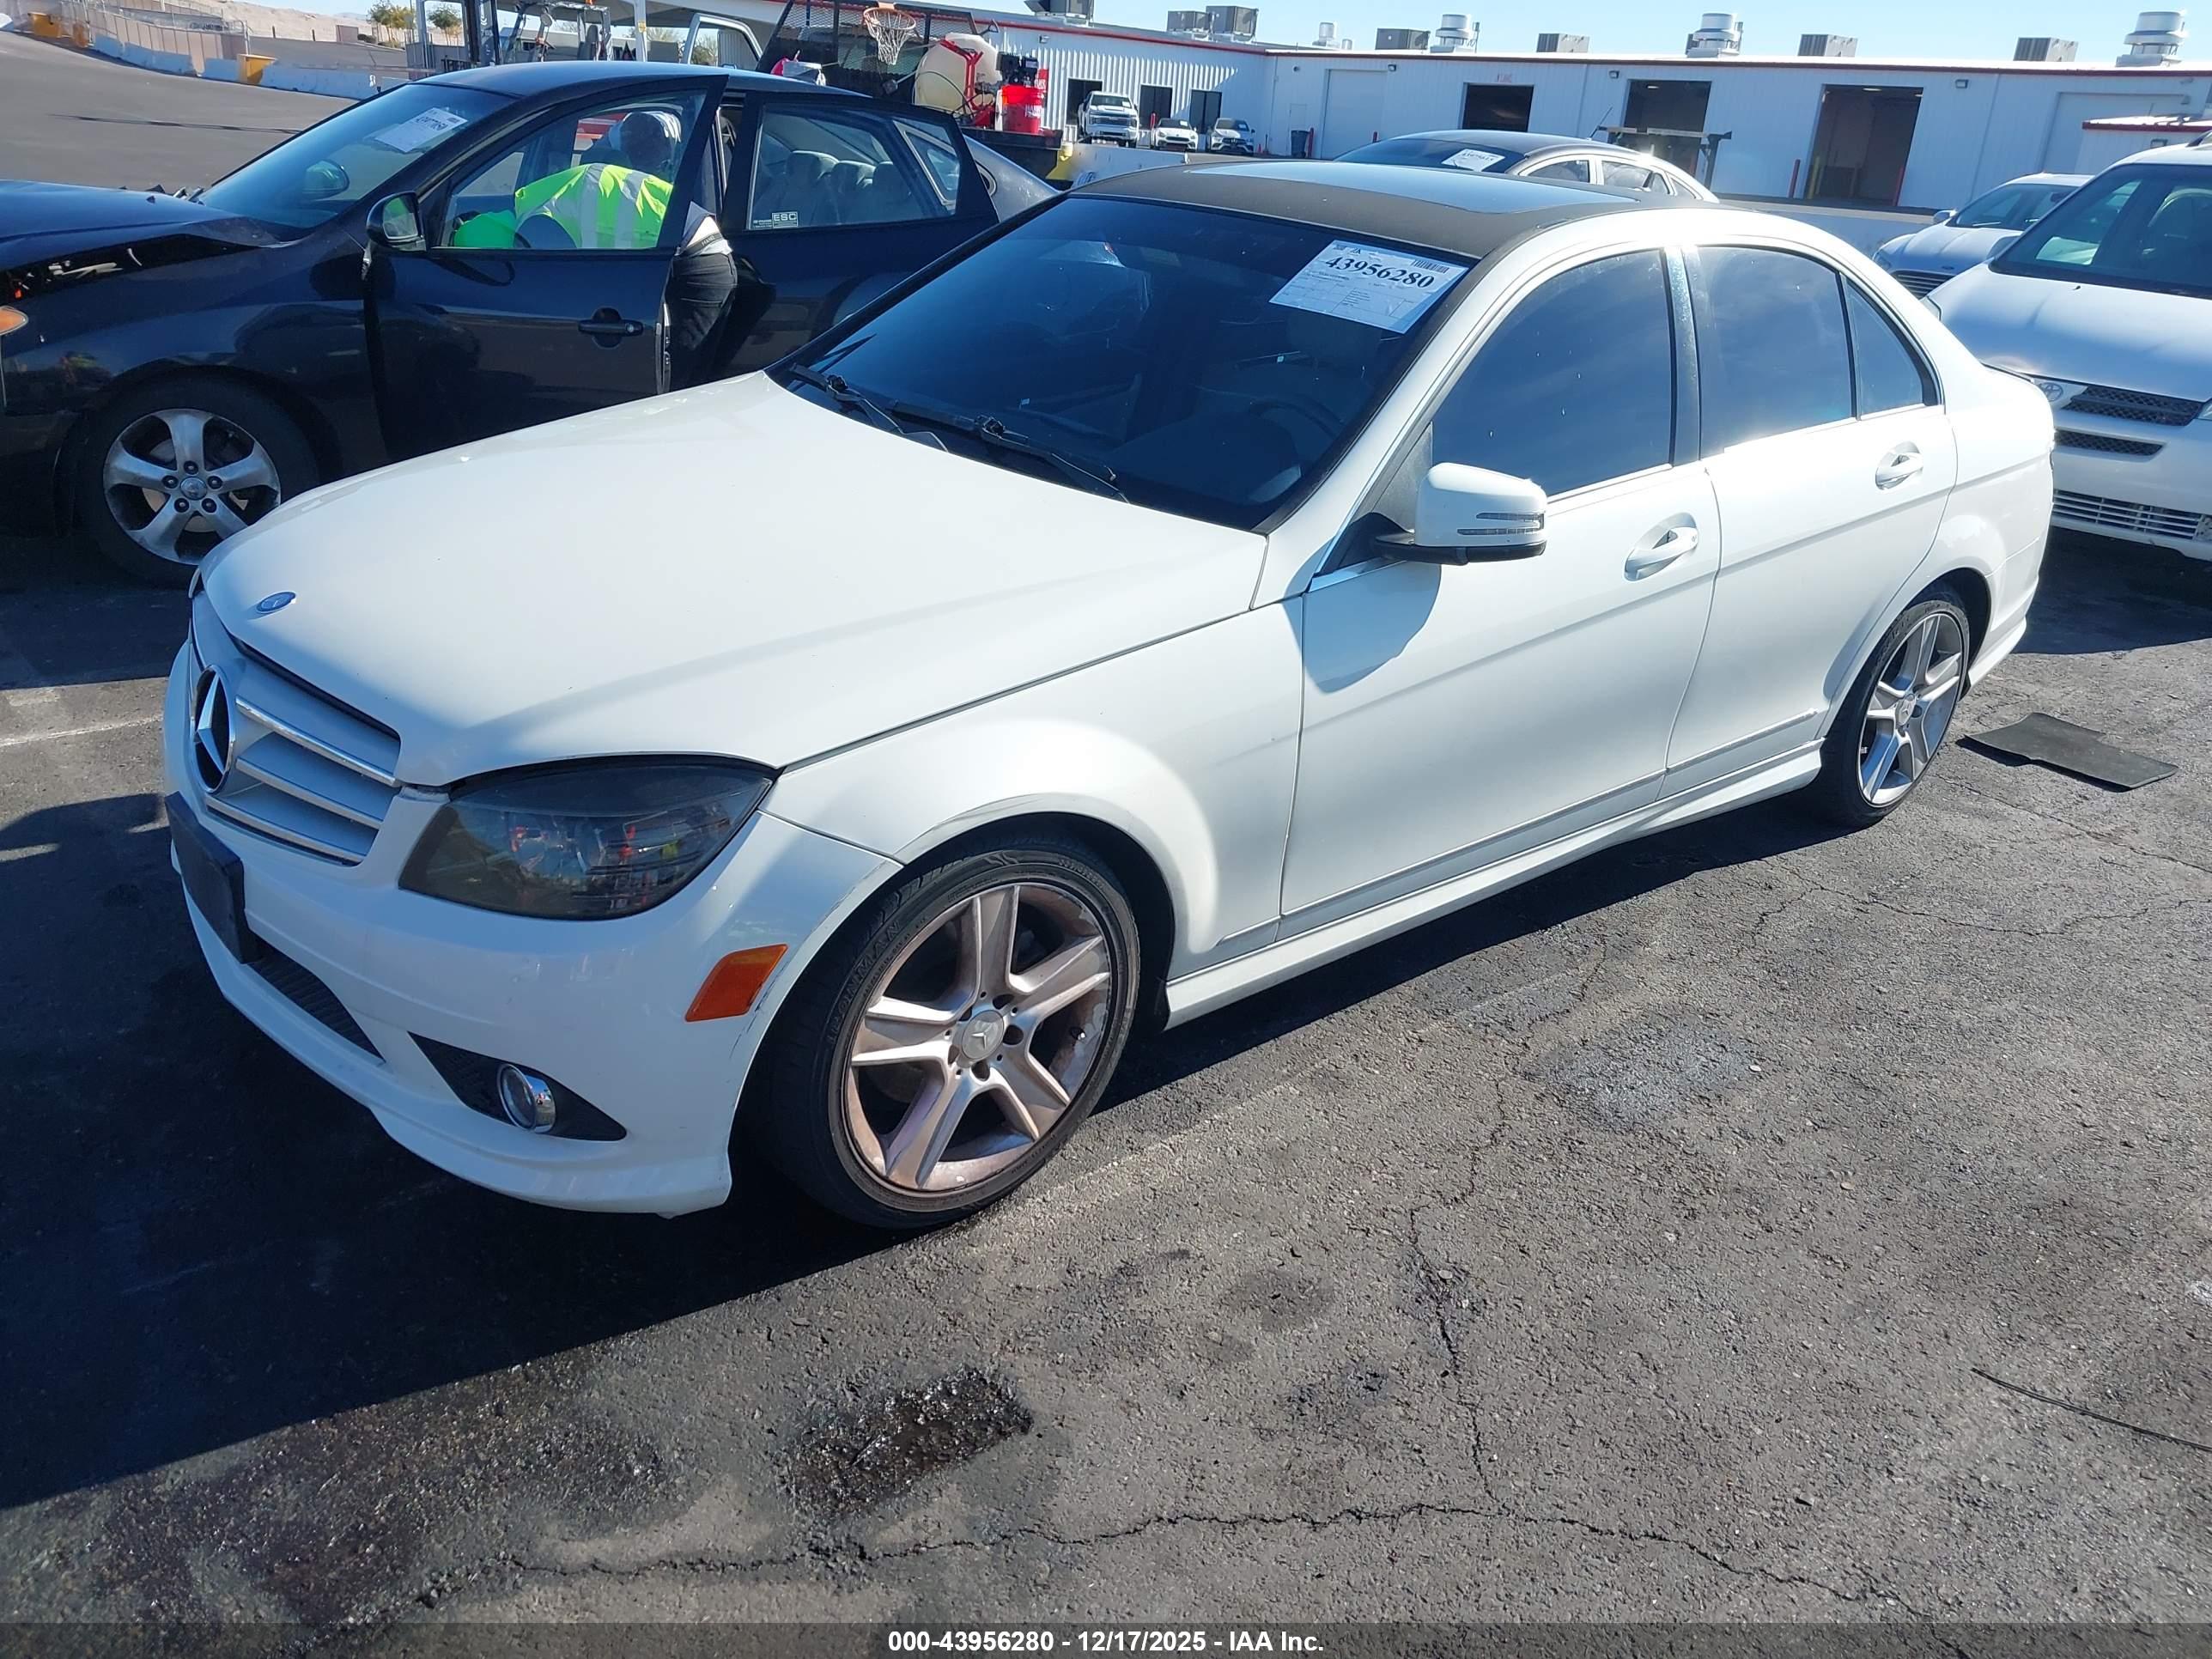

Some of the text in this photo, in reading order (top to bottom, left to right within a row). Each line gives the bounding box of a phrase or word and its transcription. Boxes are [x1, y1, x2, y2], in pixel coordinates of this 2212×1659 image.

[774, 212, 797, 222] ESC
[1326, 257, 1435, 289] 43956280
[826, 919, 902, 1044] IRONMAN
